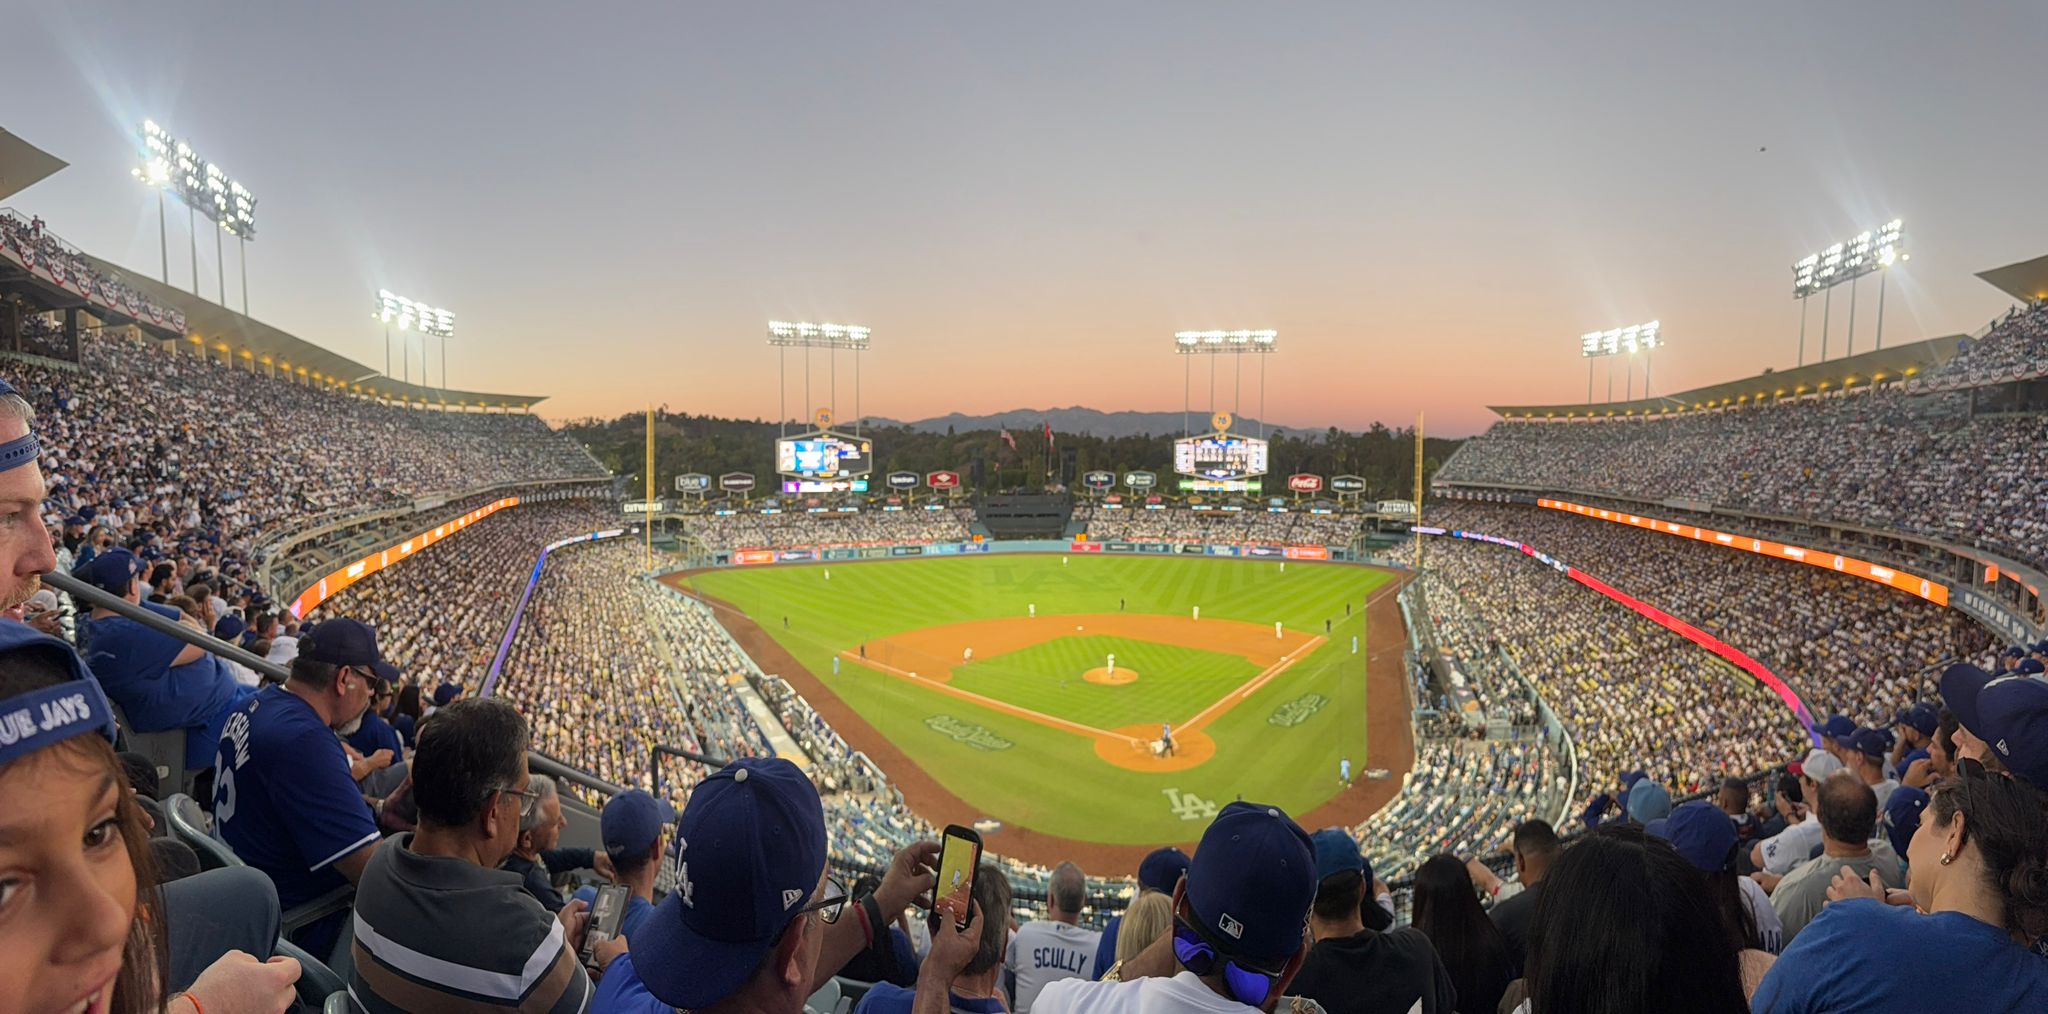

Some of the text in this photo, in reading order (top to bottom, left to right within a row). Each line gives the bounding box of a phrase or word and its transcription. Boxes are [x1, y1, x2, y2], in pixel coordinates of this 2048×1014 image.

[40, 693, 91, 731] JAYS
[219, 711, 250, 771] ERSHAW
[1162, 788, 1219, 820] LA
[1034, 946, 1088, 975] SCULLY
